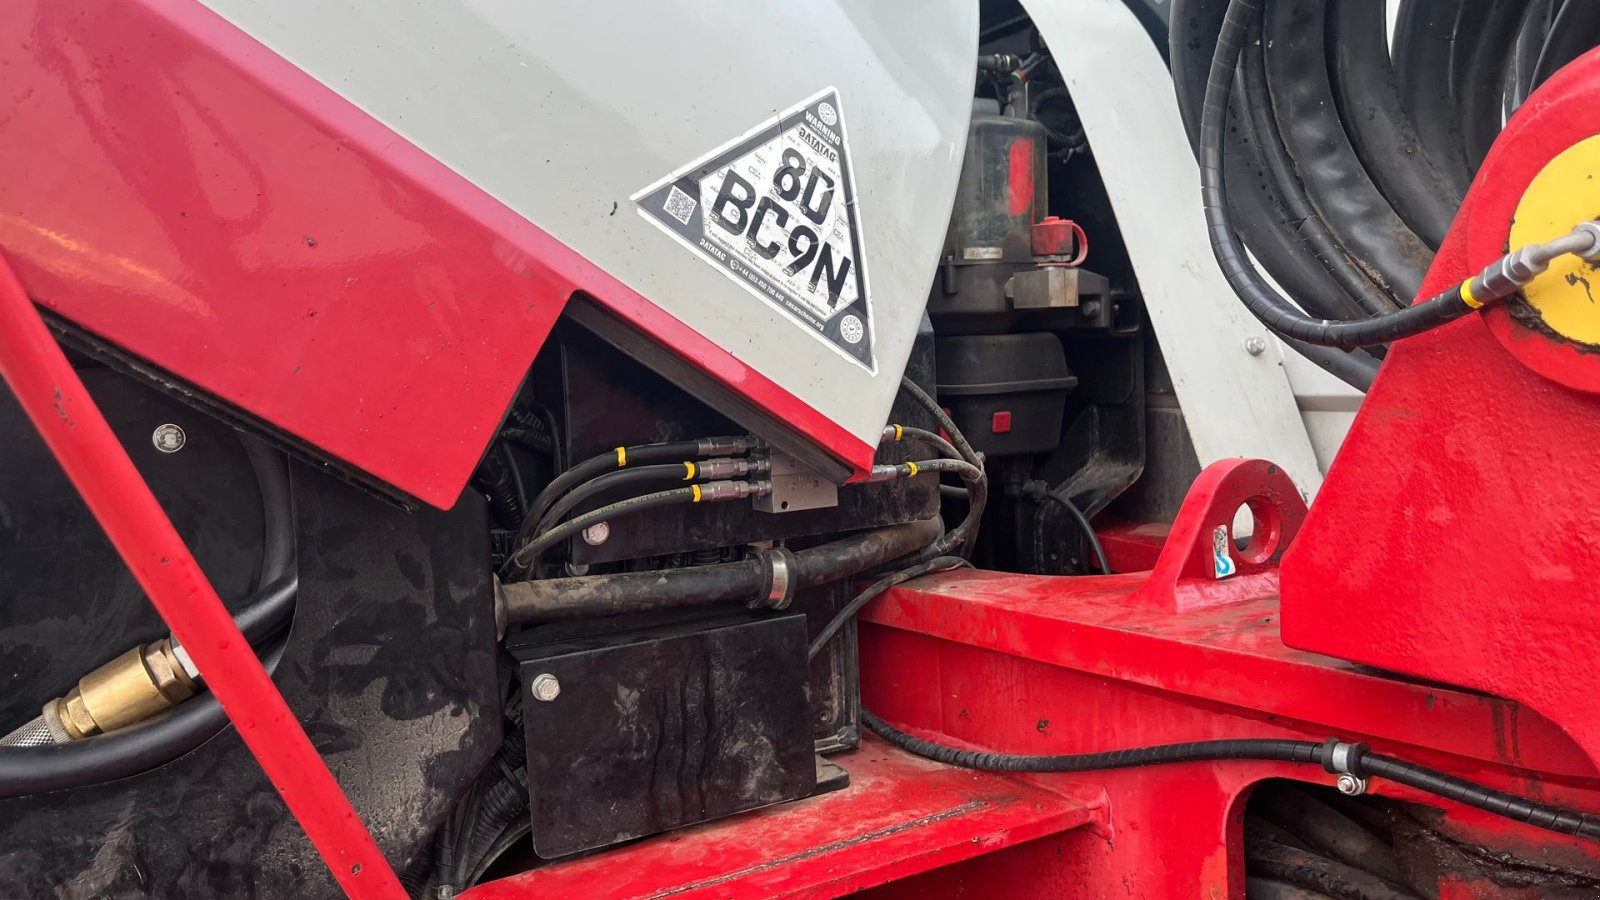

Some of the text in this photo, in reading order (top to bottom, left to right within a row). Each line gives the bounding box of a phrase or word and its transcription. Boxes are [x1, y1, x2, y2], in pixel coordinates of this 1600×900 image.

[799, 127, 836, 162] DATATAG
[805, 110, 841, 146] WARNING
[773, 147, 835, 225] 8D
[699, 238, 726, 261] DATATAG
[785, 300, 825, 331] cesarscheme.org
